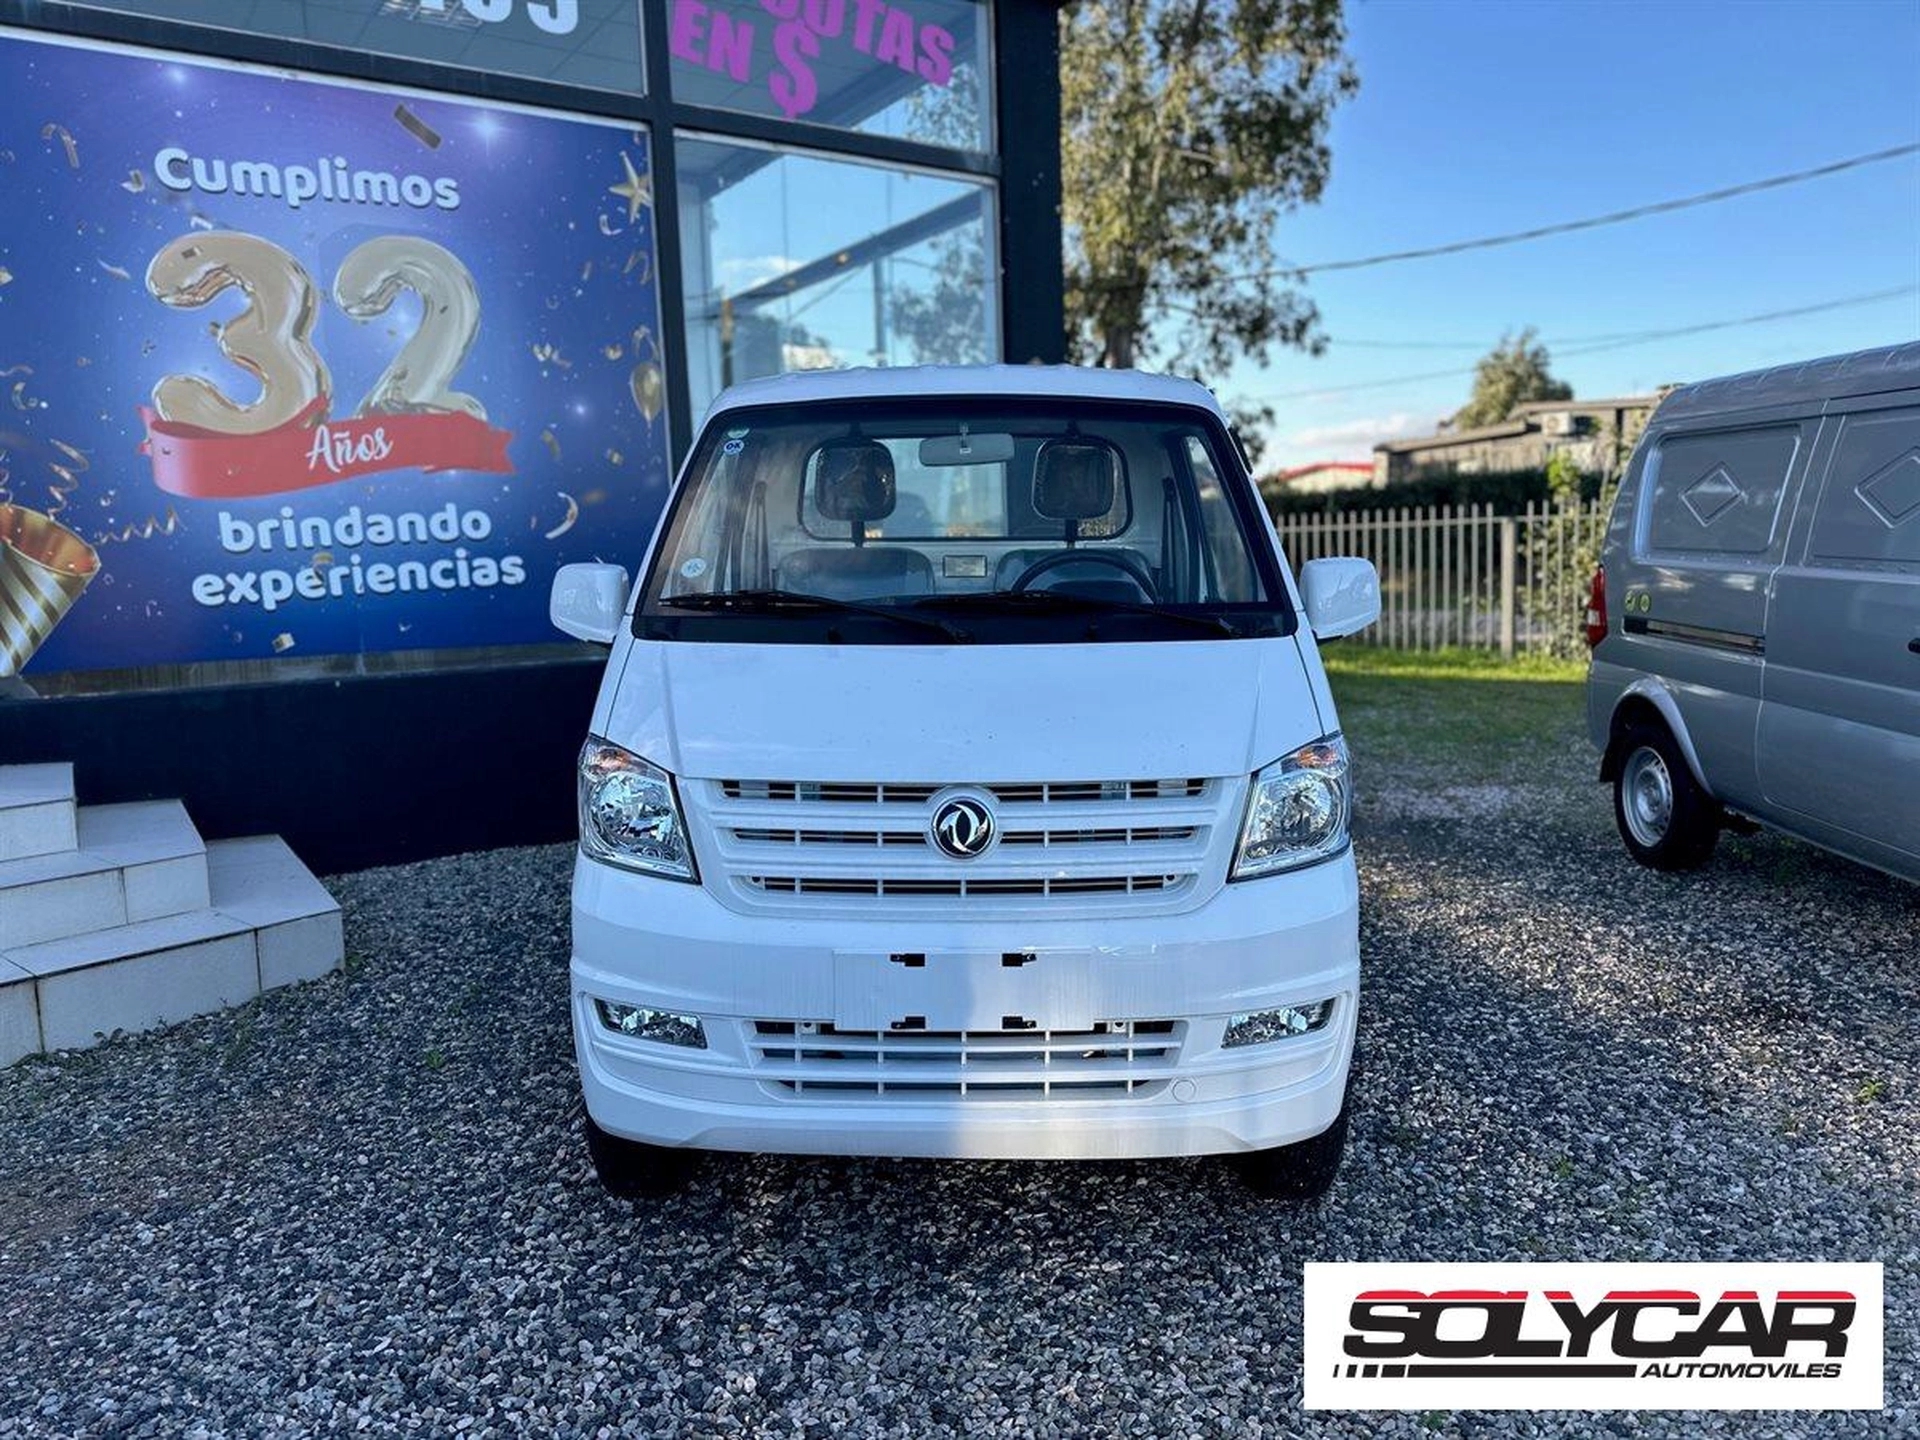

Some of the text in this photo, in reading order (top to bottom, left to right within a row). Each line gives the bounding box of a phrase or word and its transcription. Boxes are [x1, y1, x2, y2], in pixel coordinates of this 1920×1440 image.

[671, 0, 755, 83] EN
[153, 146, 461, 210] Cumplimos
[145, 228, 488, 435] 32
[305, 424, 394, 473] Años
[218, 502, 493, 556] brindando
[191, 550, 527, 612] experiencias
